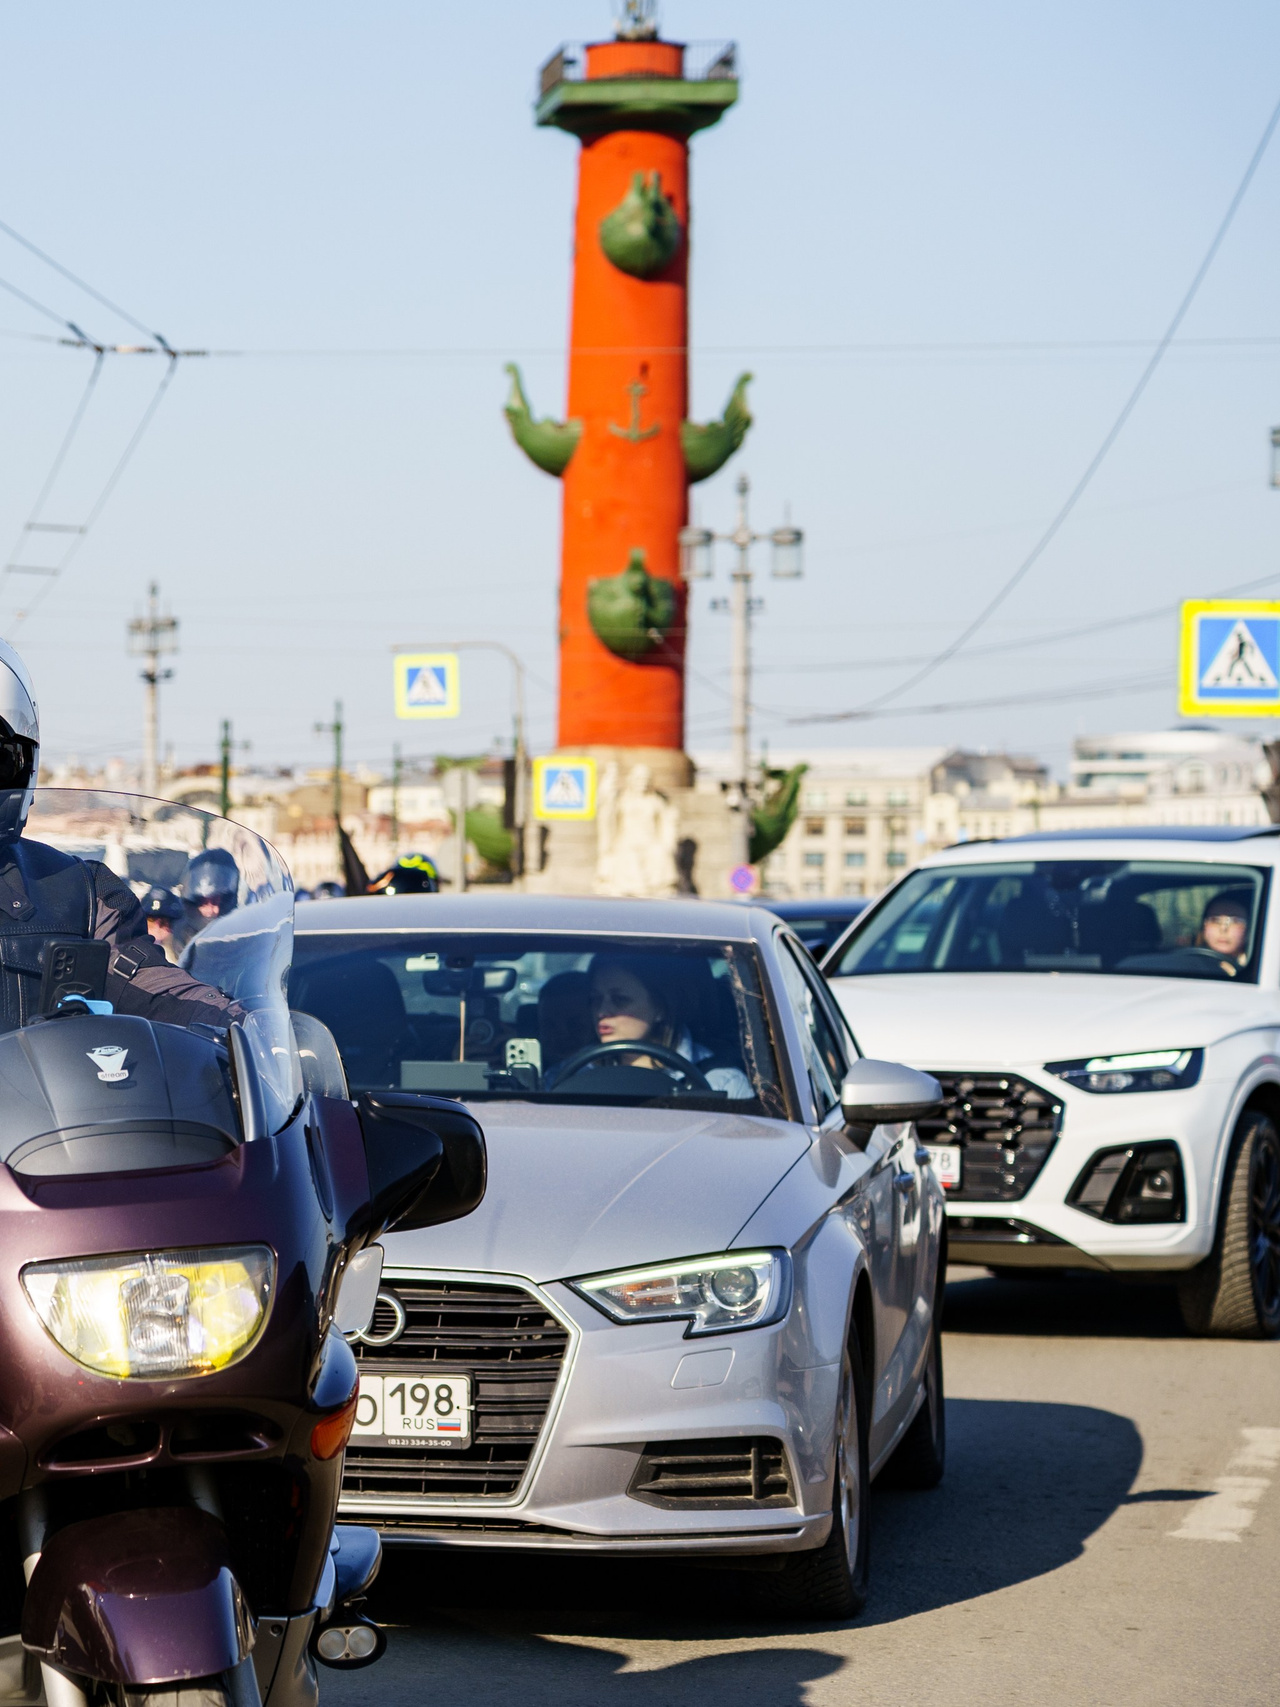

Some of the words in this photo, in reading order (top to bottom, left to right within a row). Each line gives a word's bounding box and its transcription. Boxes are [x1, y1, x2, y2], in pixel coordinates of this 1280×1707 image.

[389, 1383, 453, 1416] 198
[402, 1418, 435, 1430] RUS
[388, 1438, 409, 1446] (812)
[410, 1439, 451, 1447] 334-35-00
